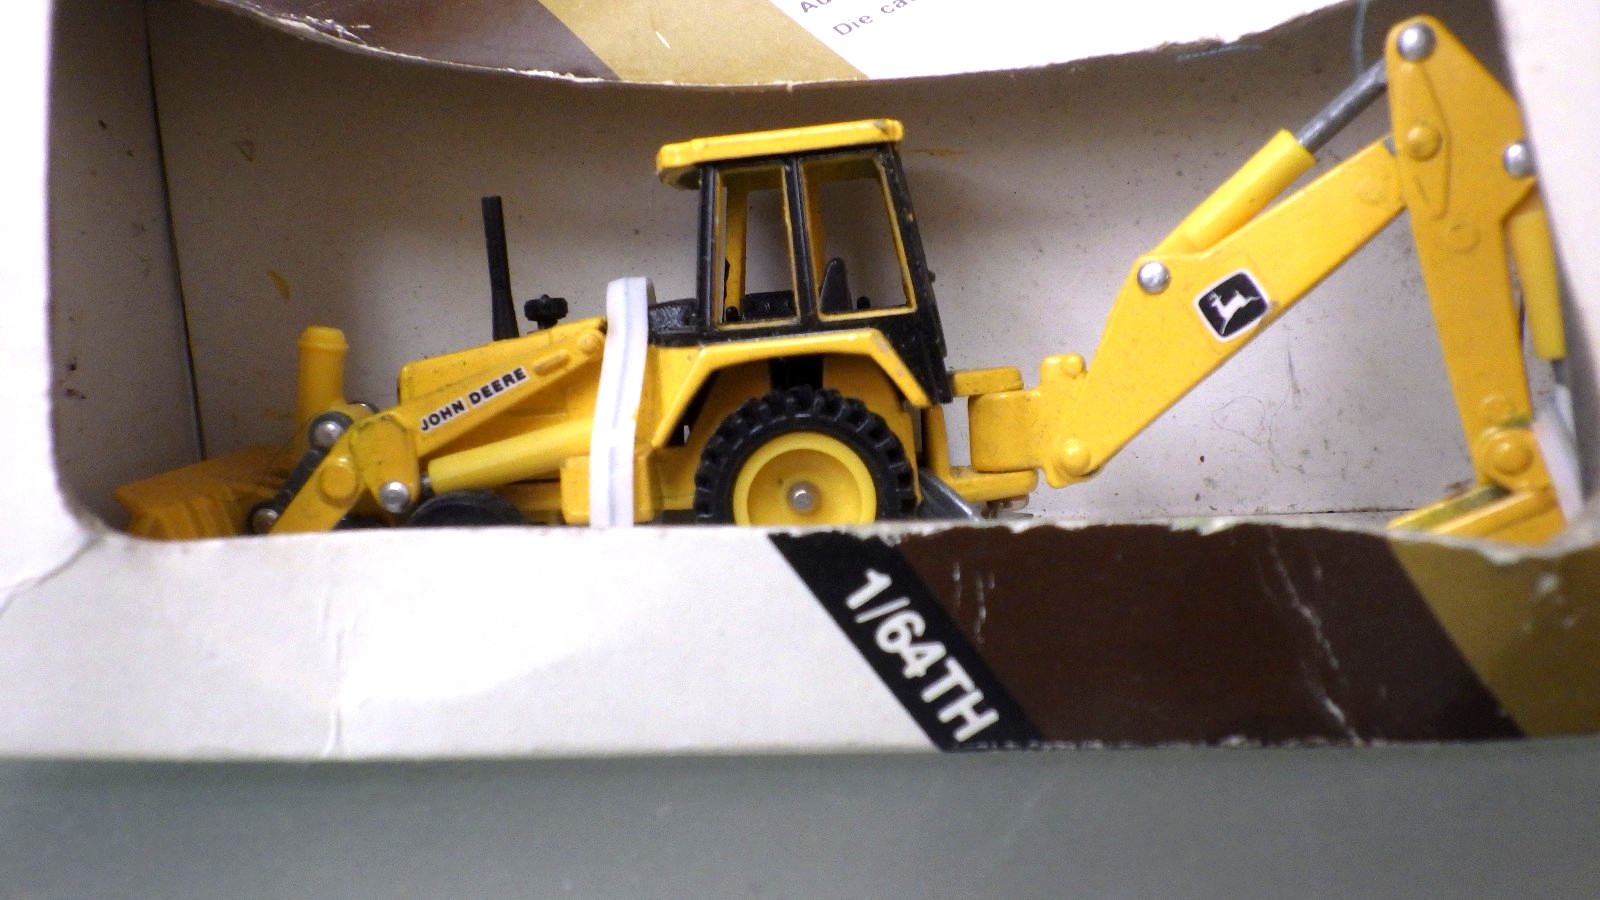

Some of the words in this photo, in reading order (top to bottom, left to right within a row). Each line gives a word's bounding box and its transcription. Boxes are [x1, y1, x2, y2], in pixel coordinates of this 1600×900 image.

[832, 15, 873, 36] Die
[880, 0, 915, 14] ca
[420, 399, 465, 431] JOHN
[468, 367, 526, 405] DEERE
[845, 568, 1000, 743] 1/64TH
